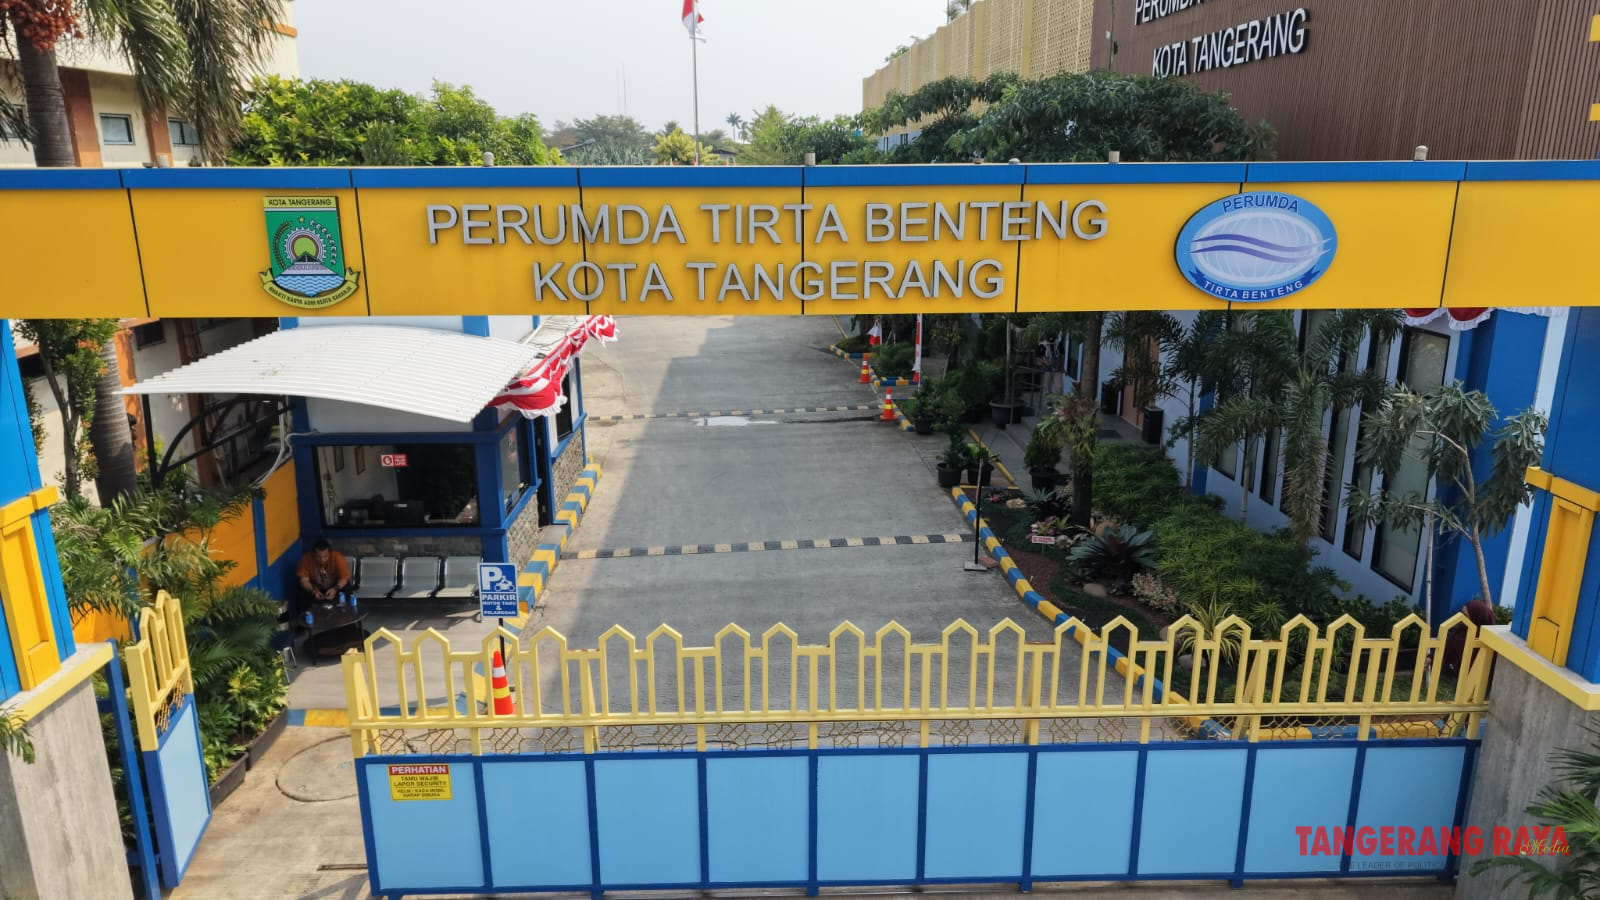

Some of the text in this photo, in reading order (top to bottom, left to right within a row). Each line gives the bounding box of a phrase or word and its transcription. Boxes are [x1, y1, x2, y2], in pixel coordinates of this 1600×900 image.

[1134, 0, 1201, 25] PERU
[1152, 8, 1307, 79] KOTA TANGERANG
[287, 198, 332, 206] TANGERANG
[1222, 194, 1299, 213] PERUMDA
[426, 200, 1108, 245] PERUMDA TIRTA BENTENG
[533, 258, 1004, 301] KOTA TANGERANG
[1204, 280, 1303, 299] TIRTA BENTENG
[481, 566, 503, 590] P
[391, 765, 446, 774] PERHATIAN
